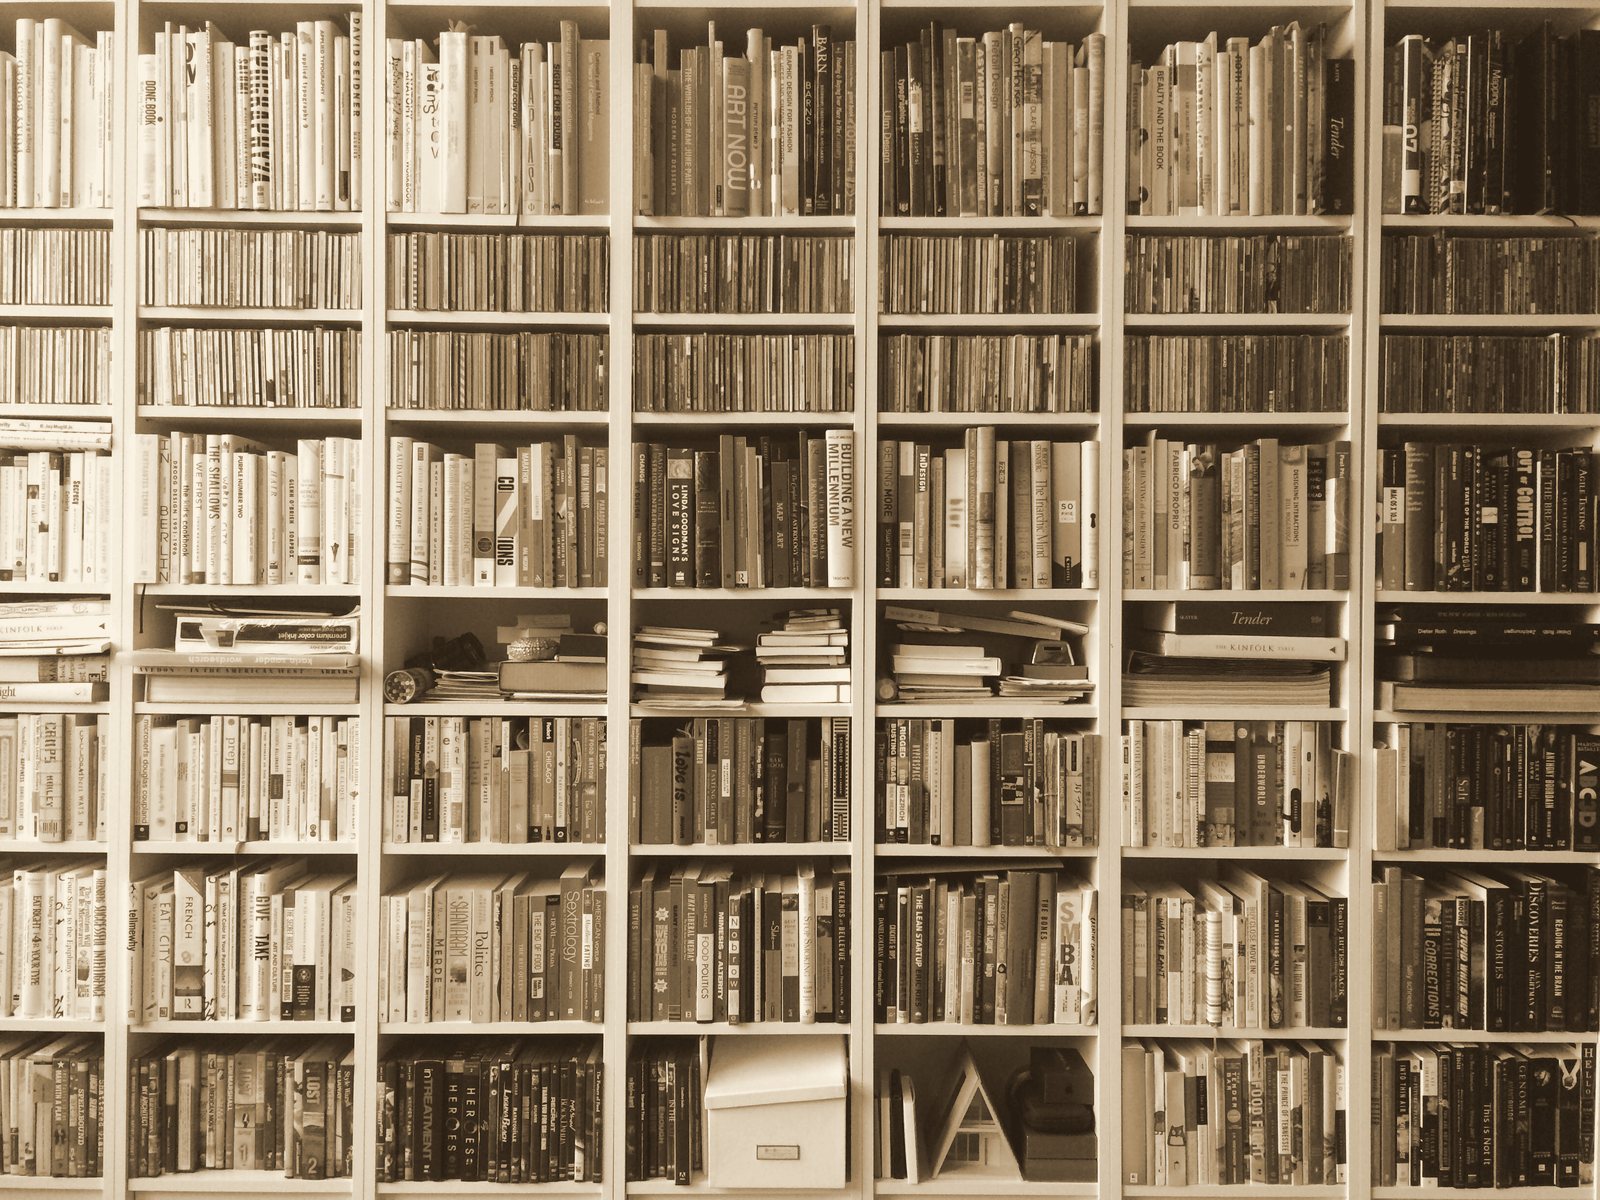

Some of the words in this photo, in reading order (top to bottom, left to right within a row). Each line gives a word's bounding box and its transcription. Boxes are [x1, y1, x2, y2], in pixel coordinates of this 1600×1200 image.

[353, 18, 361, 56] DAVID
[1013, 36, 1022, 68] Great
[301, 53, 309, 80] applied
[817, 37, 827, 73] BARN
[991, 39, 1000, 70] Retail
[353, 60, 361, 117] SEIDNER
[553, 63, 561, 91] SIGHT
[991, 73, 1000, 109] Design
[1013, 70, 1022, 109] Houses
[1156, 70, 1164, 105] BEAUTY
[1490, 69, 1501, 106] Mapping
[145, 80, 156, 126] DONE.BOOK
[301, 82, 309, 121] typography
[553, 94, 561, 112] FOR
[727, 84, 746, 129] ART
[1156, 106, 1164, 125] AND
[553, 115, 561, 148] SOUND
[883, 110, 891, 130] Ulm
[1156, 126, 1164, 143] THE
[883, 133, 891, 163] Design
[1330, 116, 1344, 159] Tender
[727, 134, 746, 191] NOW
[1156, 146, 1164, 170] BOOK
[159, 439, 170, 464] IN
[208, 445, 220, 463] THE
[883, 446, 893, 487] GETTING
[195, 462, 202, 478] WE
[521, 452, 529, 484] MARATHON
[841, 443, 852, 503] BUILDING
[1172, 449, 1180, 489] FABRICO
[72, 480, 81, 505] Secrecy
[208, 466, 220, 520] SHALLOWS
[463, 481, 471, 506] SOCIAL
[828, 443, 839, 526] MILLENNIUM
[1543, 480, 1552, 500] THE
[672, 485, 680, 517] LOVE
[841, 507, 852, 515] A
[883, 488, 893, 517] MORE
[1172, 491, 1181, 530] PRÓPRIO
[463, 507, 471, 554] INTELLIGENCE
[841, 518, 852, 548] NEW
[1543, 502, 1552, 541] BREACH
[159, 505, 170, 583] BERLIN
[672, 524, 680, 562] SIGNS
[1231, 611, 1273, 625] Tender
[1229, 644, 1275, 652] KINFOLK
[142, 719, 150, 757] microserfs
[225, 737, 236, 766] prep
[696, 739, 704, 764] BRANDED
[142, 759, 150, 789] douglas
[911, 744, 921, 781] HYPERSPACE
[1134, 740, 1142, 779] KOREAN
[1544, 751, 1555, 777] ANTHONY
[1134, 782, 1142, 802] WAR
[1257, 754, 1265, 806] UNDERWORLD
[1544, 779, 1555, 809] BOURDAIN
[1579, 760, 1598, 827] ABC3D
[142, 790, 150, 824] coupland
[65, 896, 74, 915] Steps
[159, 902, 170, 922] EAT
[256, 895, 270, 922] GIVE
[838, 880, 846, 918] WEEKENDS
[915, 894, 923, 910] THE
[1040, 899, 1049, 913] THE
[66, 917, 73, 925] to
[126, 909, 138, 952] tellmewhy
[185, 896, 193, 939] FRENCH
[449, 901, 468, 957] SHANTARAM
[560, 890, 580, 964] Sextrology
[594, 899, 602, 939] AMERICAN
[915, 911, 923, 931] LEAN
[1040, 916, 1049, 941] BONES
[254, 933, 270, 961] TAKE
[534, 943, 541, 951] OF
[838, 926, 846, 961] BELLEVUE
[1459, 927, 1468, 962] STUPID
[1554, 919, 1563, 948] READING
[64, 939, 74, 974] Epiphany
[159, 935, 170, 963] CITY
[434, 938, 445, 983] MERDE
[474, 931, 489, 977] Politics
[701, 936, 710, 962] FOOD
[915, 933, 923, 967] STARTUP
[1495, 930, 1504, 979] STORIES
[1554, 951, 1563, 959] IN
[701, 963, 710, 999] POLITICS
[1425, 940, 1439, 1017] CORRECTIONS
[1459, 963, 1468, 991] WHITE
[1554, 961, 1563, 974] THE
[914, 989, 922, 1007] RIES
[1554, 975, 1563, 996] BRAIN
[1459, 993, 1468, 1017] MEN
[1281, 1073, 1289, 1085] THE
[1399, 1064, 1407, 1081] INTO
[140, 1085, 148, 1094] MY
[306, 1076, 321, 1105] LOST
[1251, 1081, 1264, 1115] FOOD
[1281, 1086, 1289, 1107] PRINCE
[1399, 1083, 1407, 1099] THIN
[140, 1096, 148, 1127] ARCHITECT
[1399, 1101, 1407, 1112] AIR
[1483, 1103, 1491, 1122] This
[1251, 1120, 1264, 1159] FIGHT
[1281, 1119, 1289, 1152] TENNESSEE
[1483, 1126, 1491, 1134] is
[1483, 1137, 1491, 1155] Not
